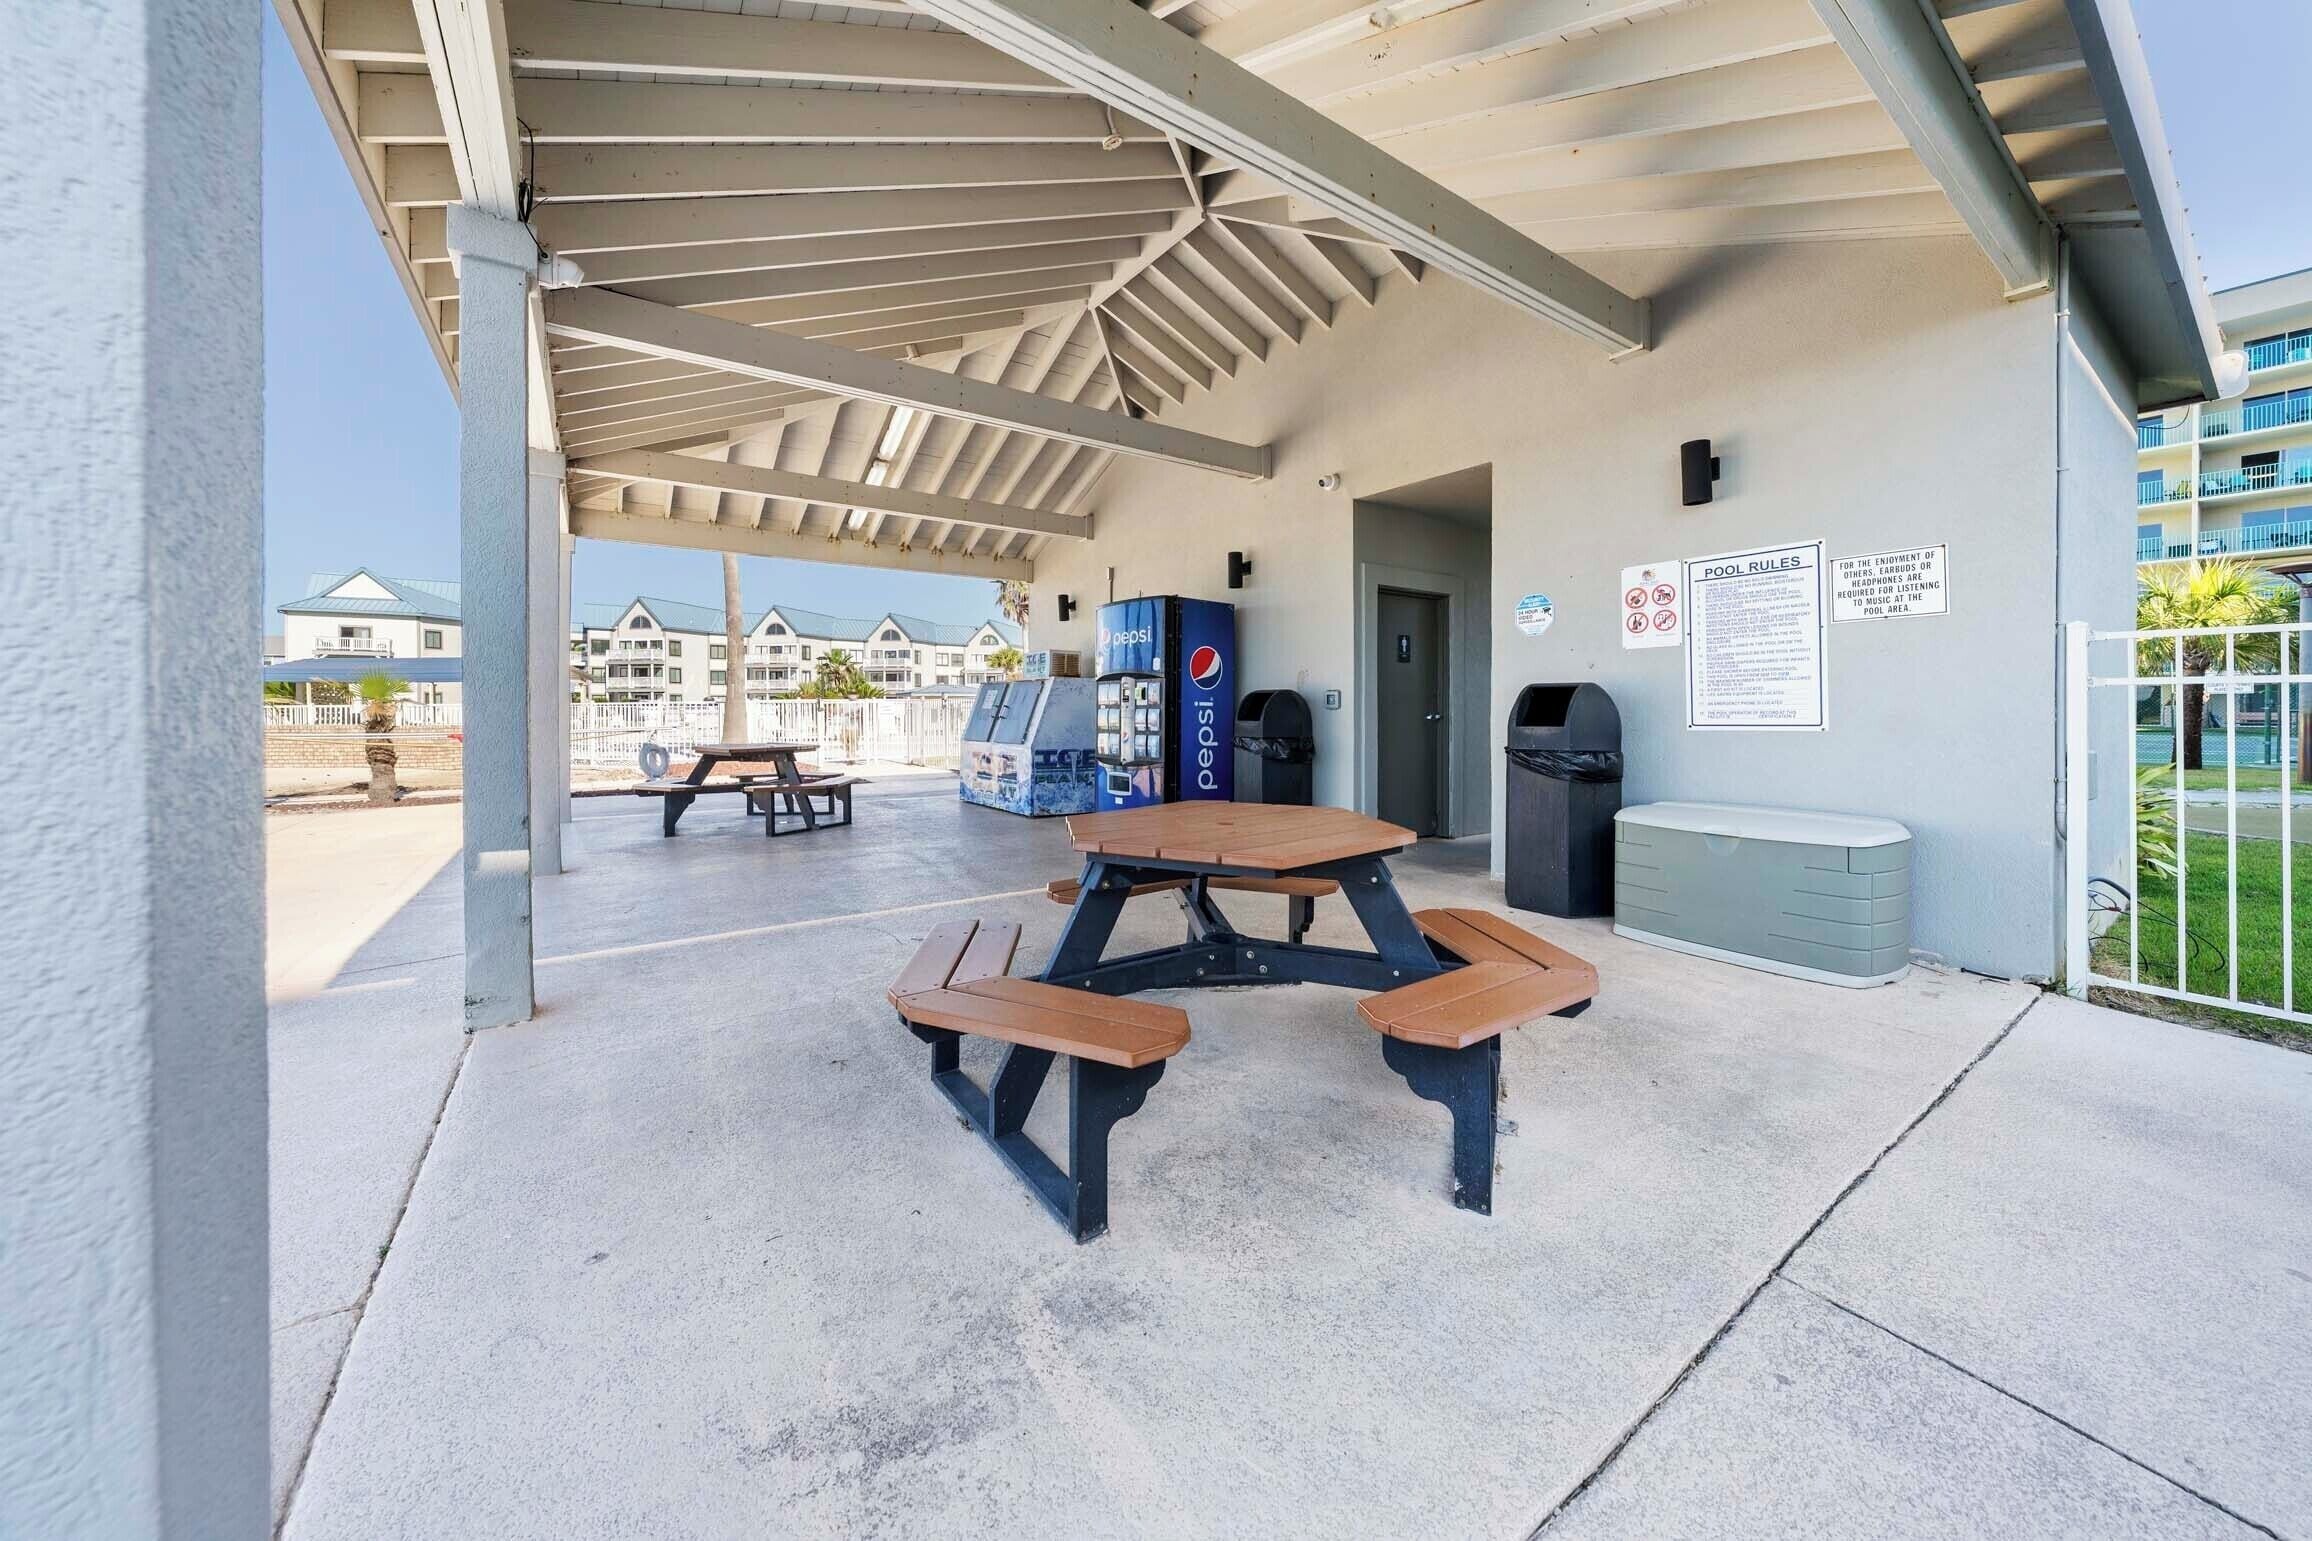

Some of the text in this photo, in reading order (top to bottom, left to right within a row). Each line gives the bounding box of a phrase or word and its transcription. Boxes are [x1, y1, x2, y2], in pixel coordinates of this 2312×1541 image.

[1704, 564, 1744, 578] POOL
[1749, 556, 1801, 572] RULES
[1840, 550, 1935, 570] FOR THE ENJOYMENT OF
[1880, 564, 1916, 574] EARBUDS
[1920, 561, 1931, 570] OR
[1852, 573, 1922, 588] HEADPHONES ARE
[1838, 581, 1940, 599] REQUIRED FOR LISTENING
[1866, 596, 1891, 605] MUSIC
[1894, 595, 1904, 603] AT
[1908, 593, 1922, 601] THE
[1864, 604, 1912, 616] POOL AREA.
[1113, 626, 1152, 648] pepsi
[1027, 653, 1046, 664] ICE
[1194, 701, 1219, 790] pepsi
[1035, 749, 1095, 768] ICE
[1035, 774, 1094, 785] PLAN
